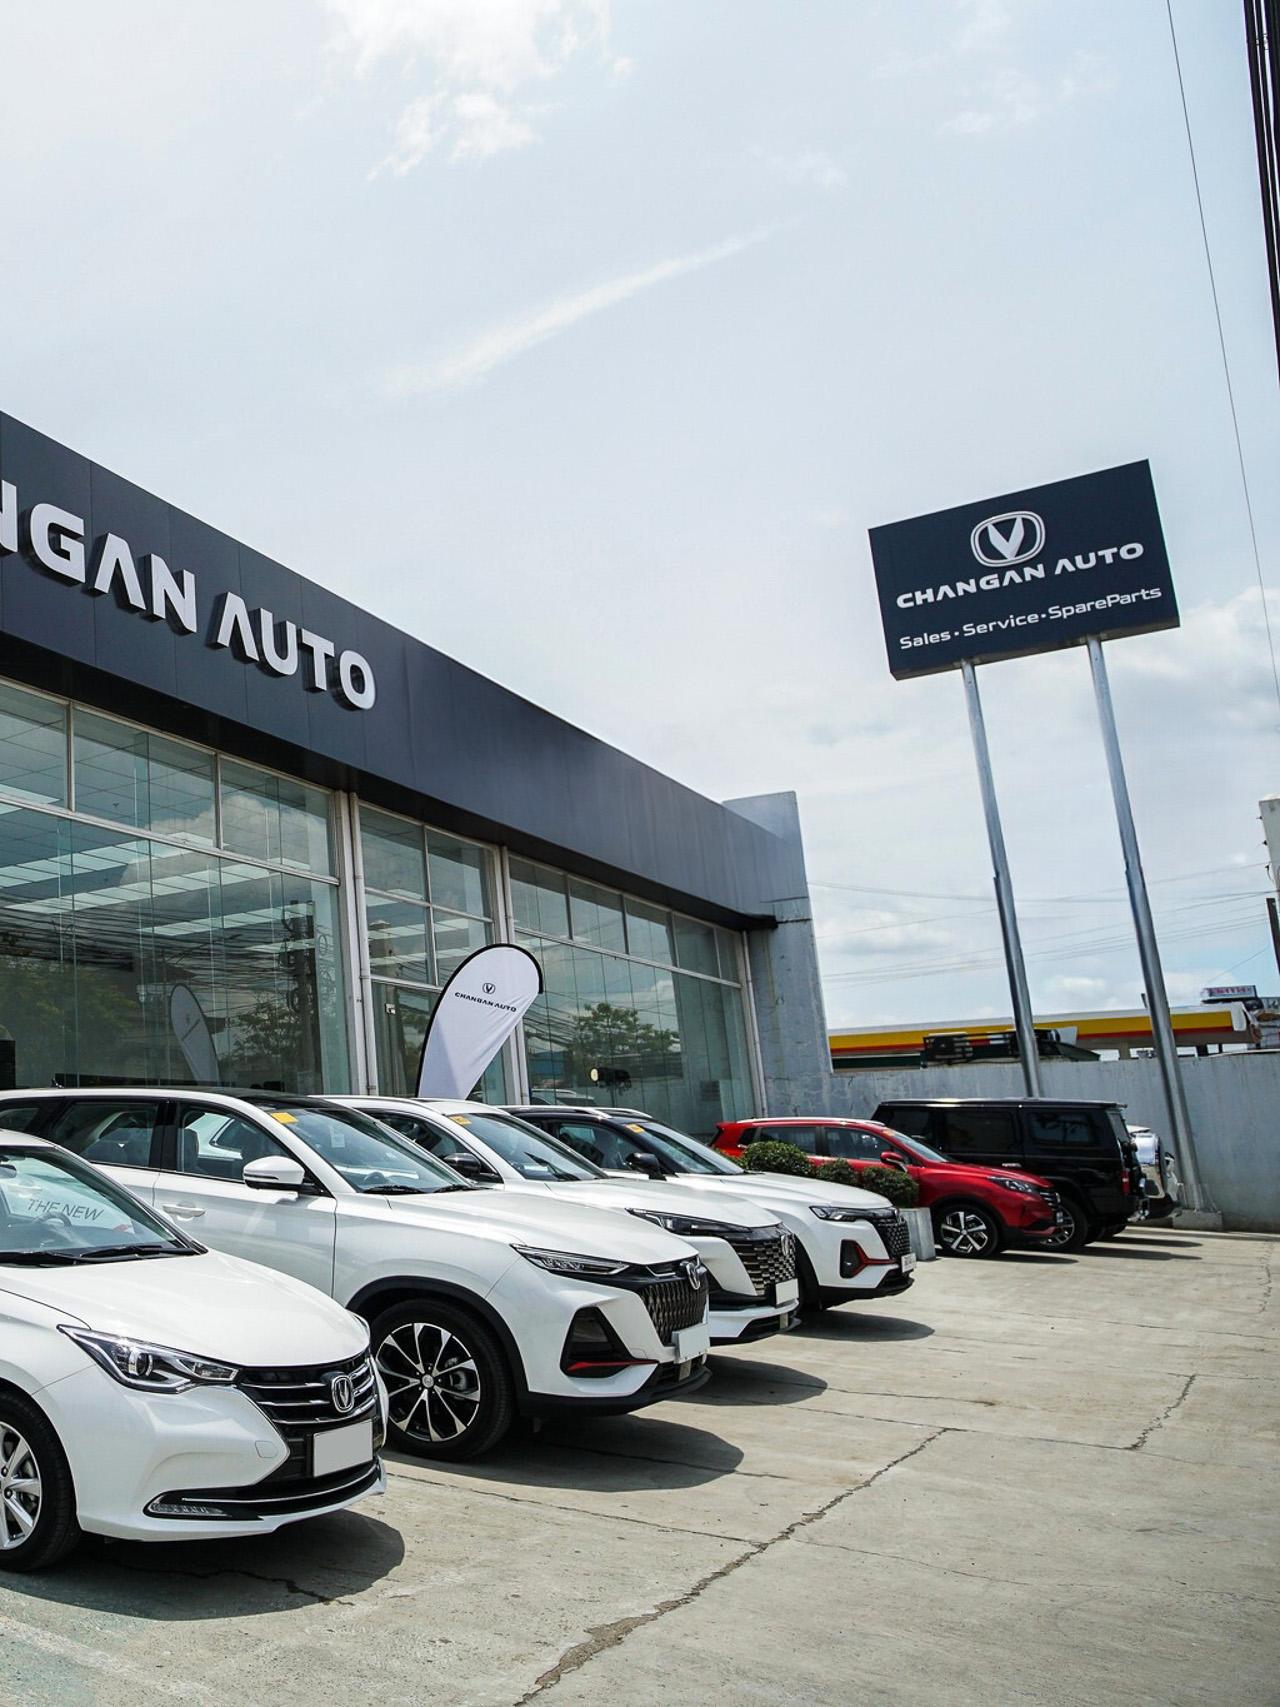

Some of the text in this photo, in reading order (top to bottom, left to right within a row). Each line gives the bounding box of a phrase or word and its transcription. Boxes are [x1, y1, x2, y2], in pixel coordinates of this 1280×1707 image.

[896, 543, 1144, 609] CHANGAN AUTO
[899, 629, 951, 650] Sales
[963, 613, 1039, 636] Service
[215, 591, 376, 710] AUTO
[454, 992, 517, 1012] CHANGAN AUTO
[27, 1199, 105, 1220] THE NEW
